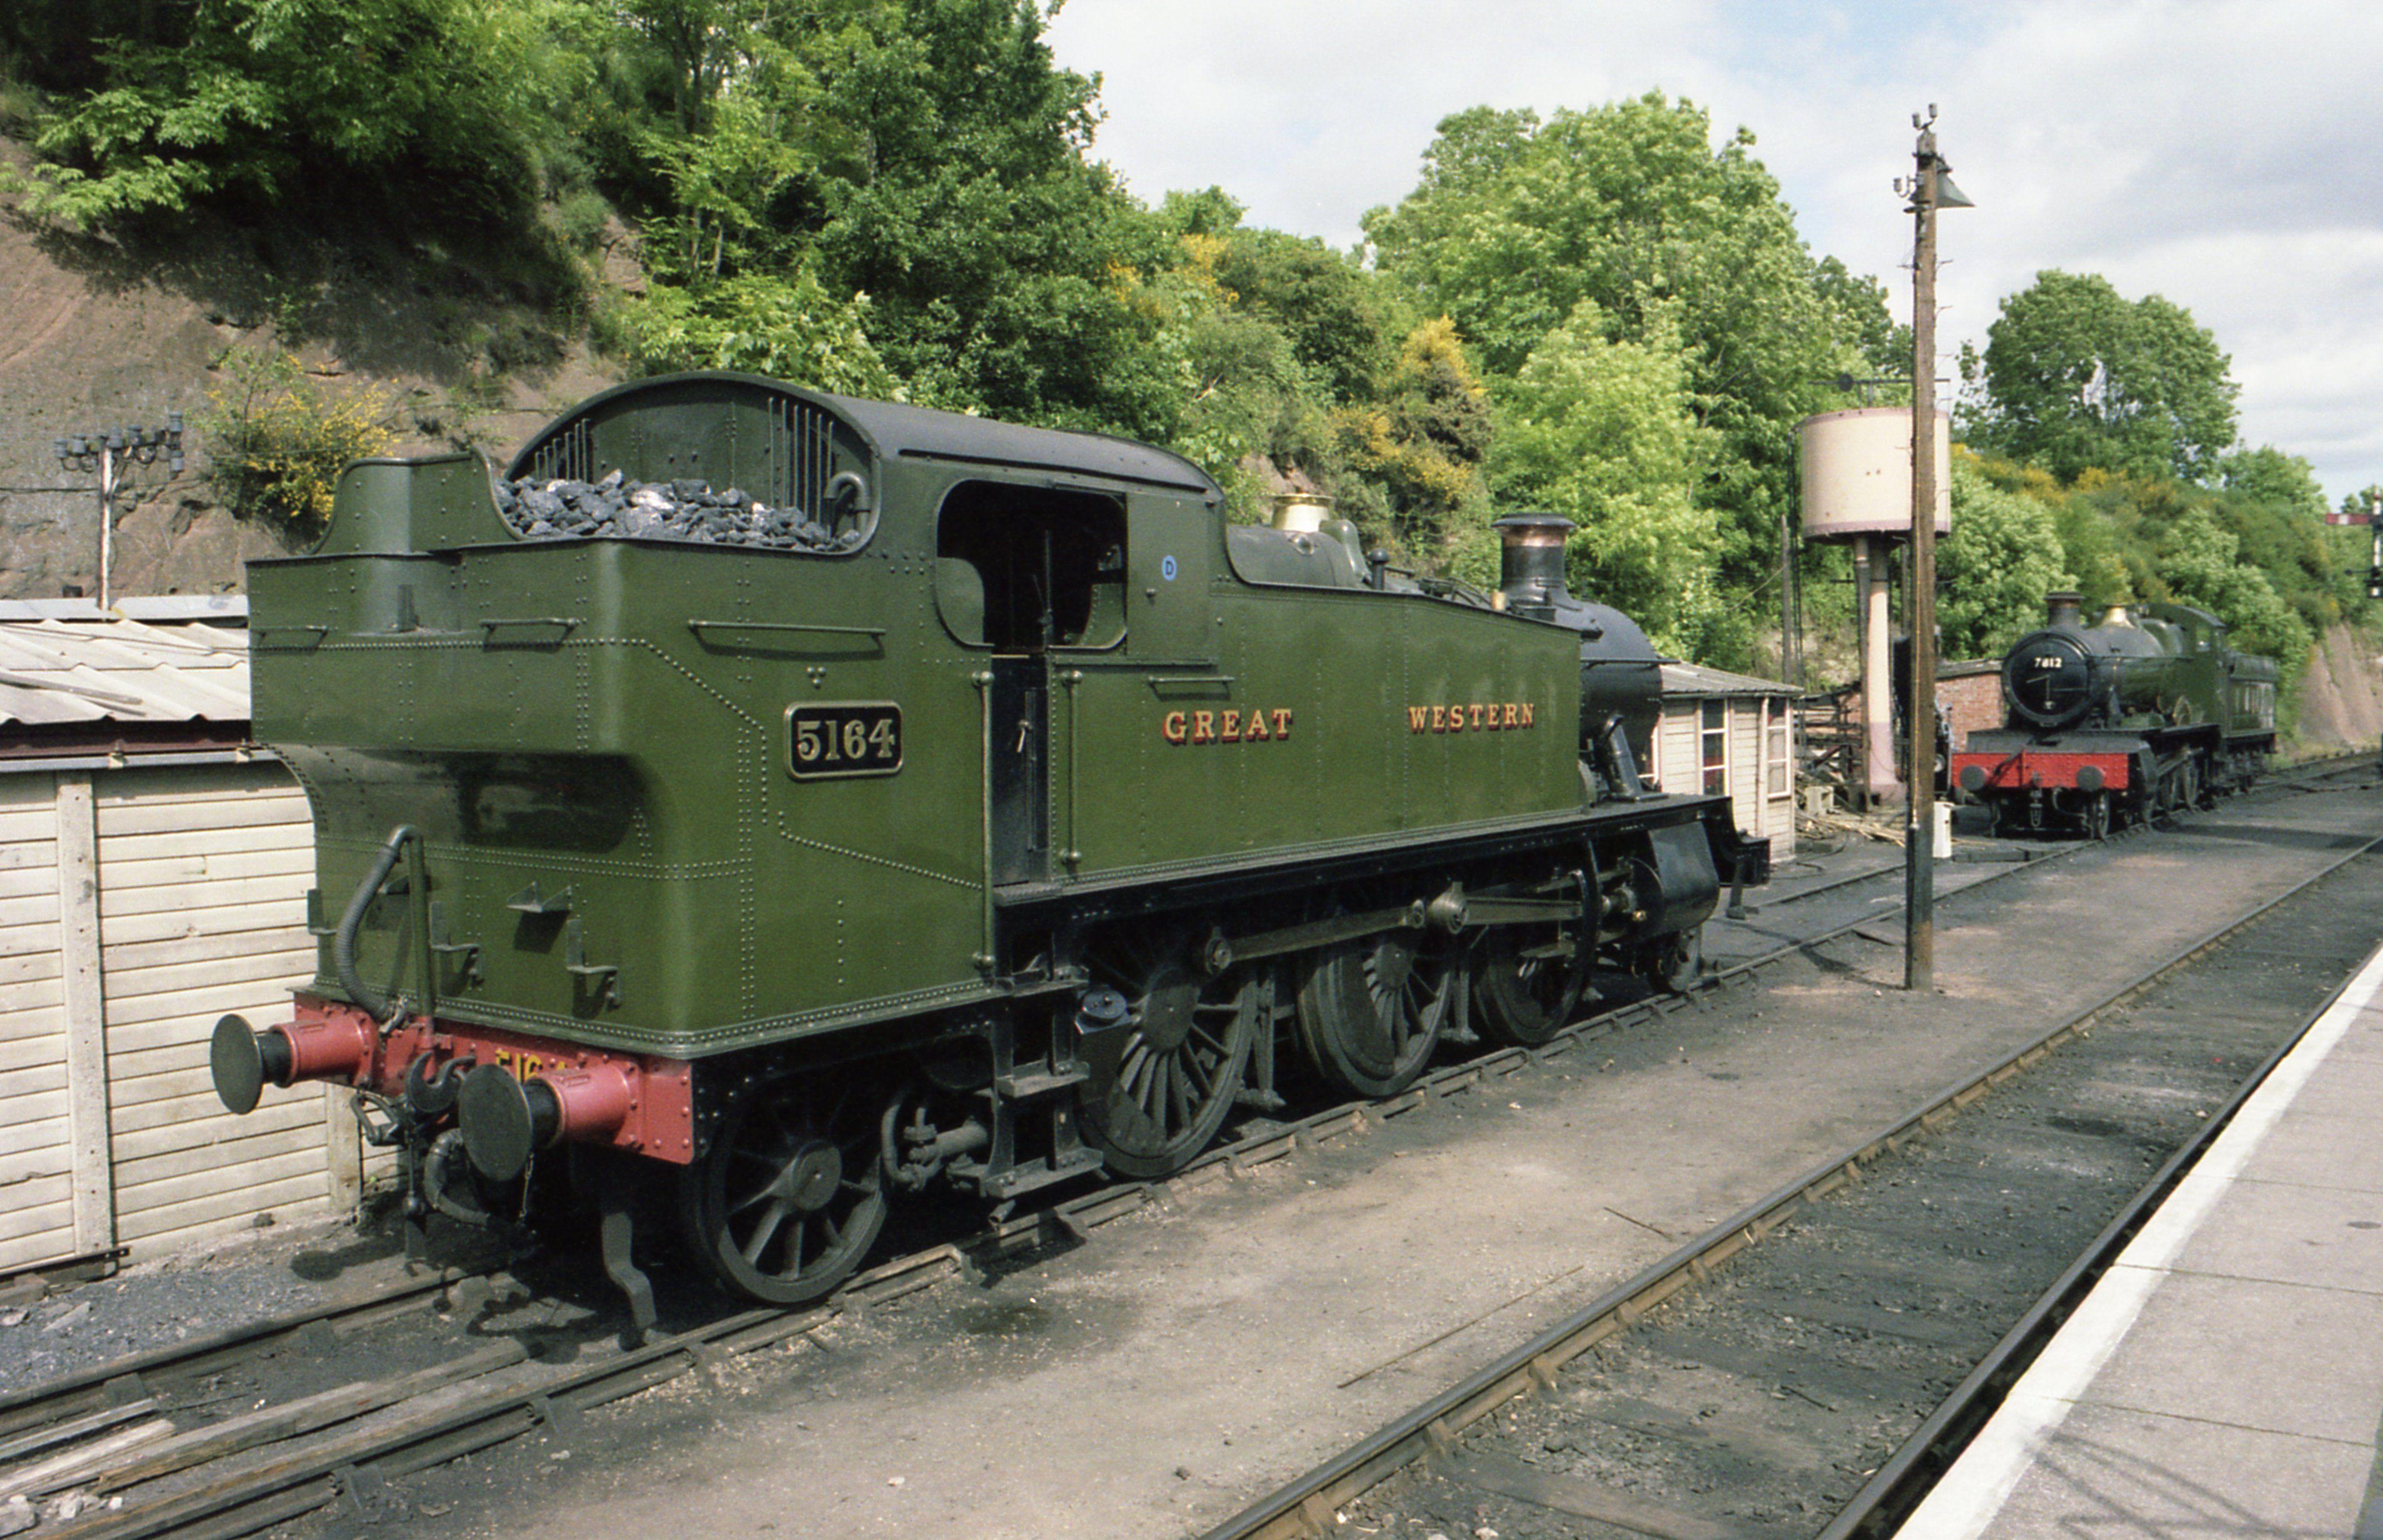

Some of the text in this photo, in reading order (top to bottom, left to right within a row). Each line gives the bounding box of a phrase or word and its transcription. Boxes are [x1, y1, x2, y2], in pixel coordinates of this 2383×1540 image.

[2034, 656, 2063, 669] 7812
[797, 719, 895, 761] 5164
[1162, 703, 1534, 745] GREAT WESTERN
